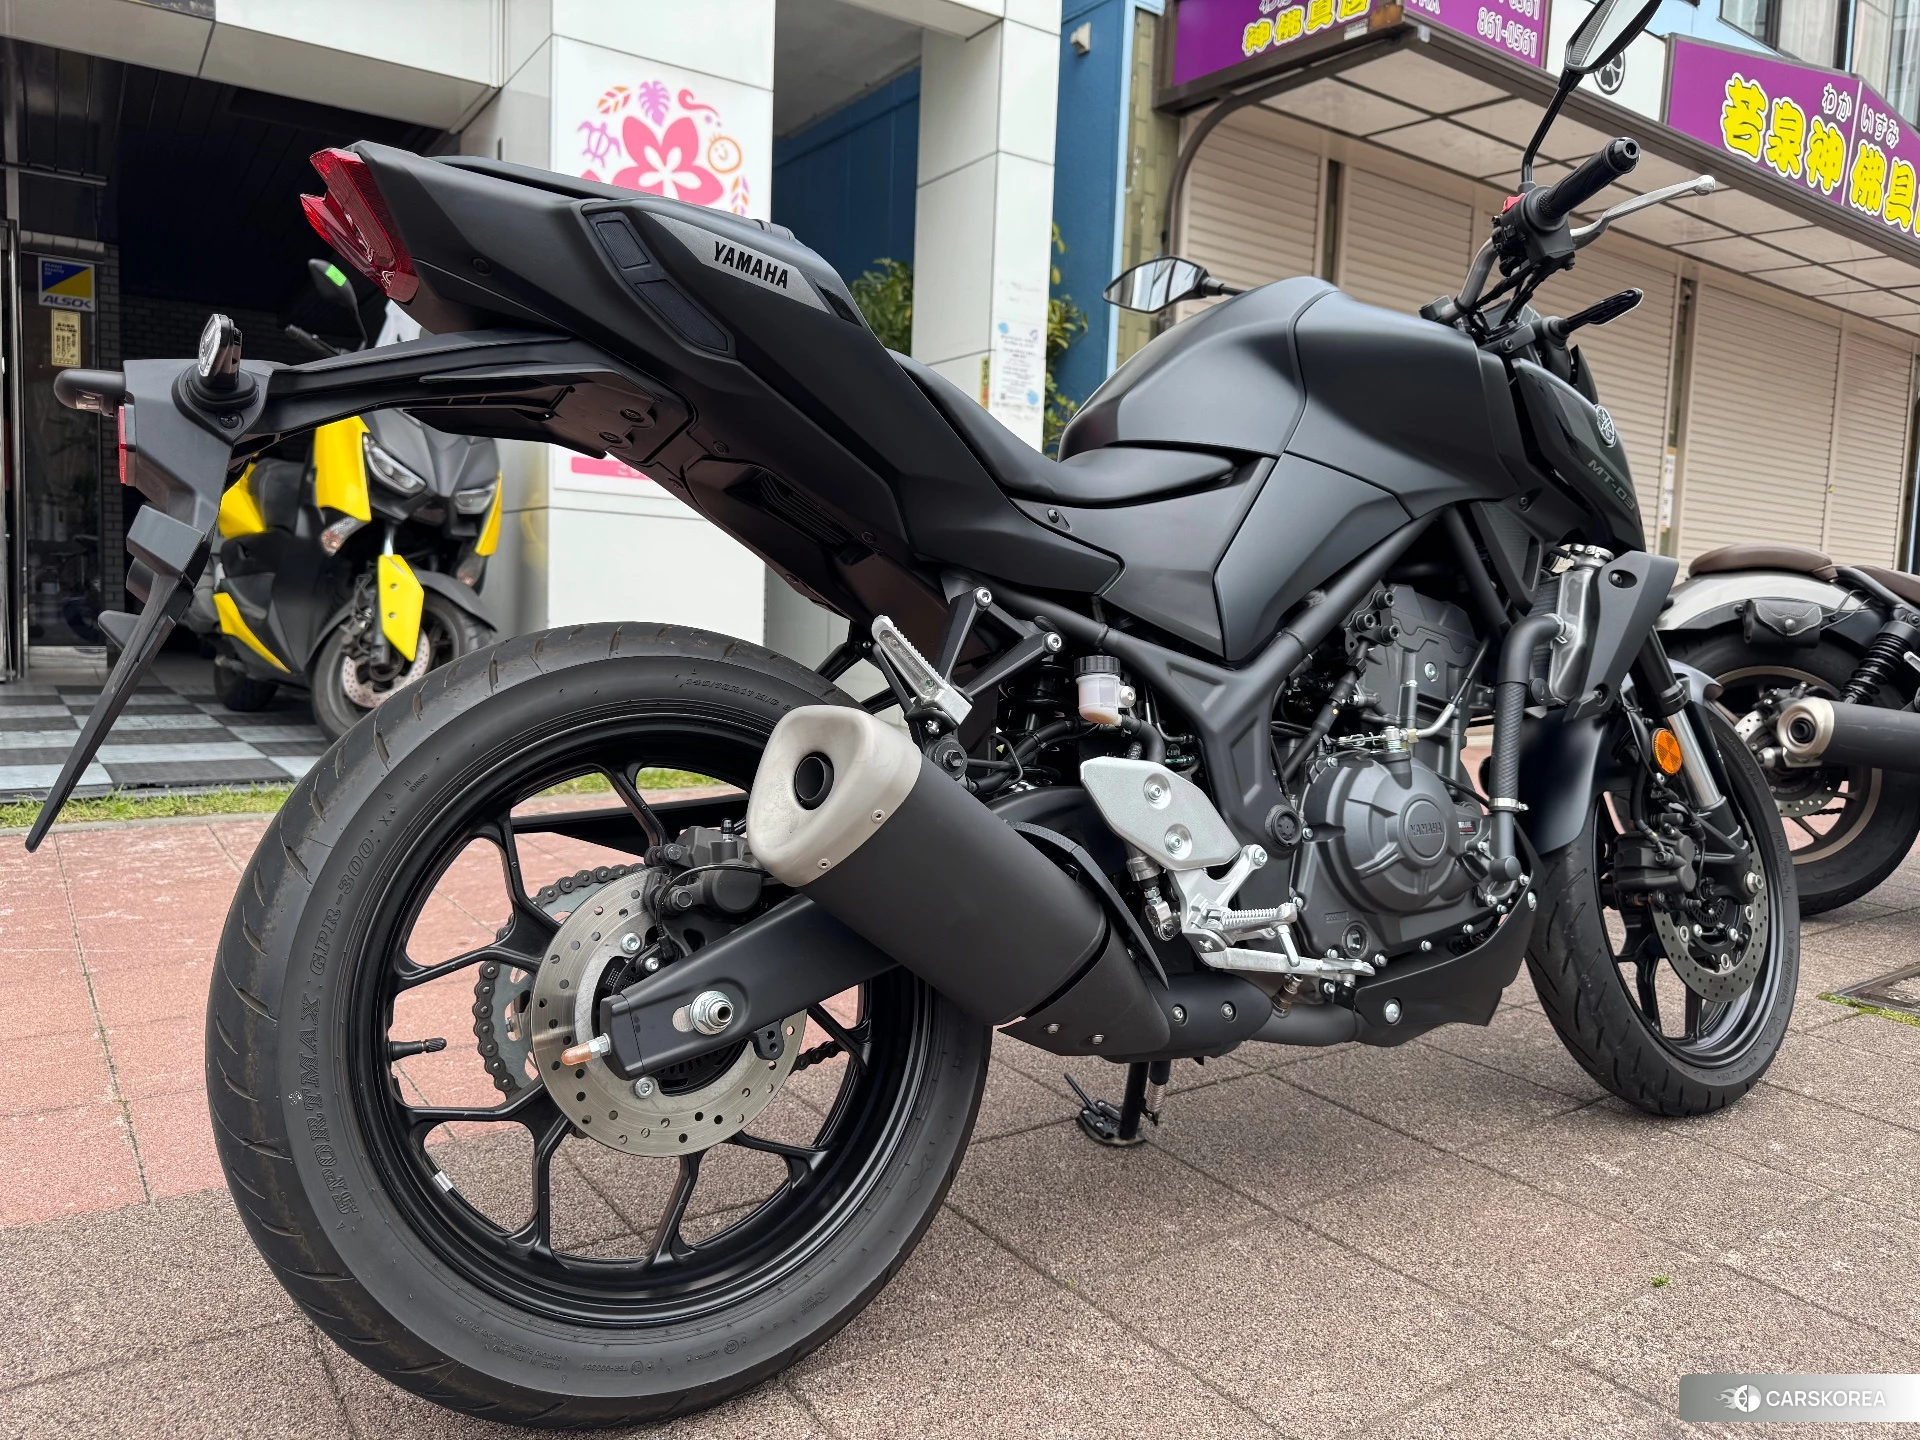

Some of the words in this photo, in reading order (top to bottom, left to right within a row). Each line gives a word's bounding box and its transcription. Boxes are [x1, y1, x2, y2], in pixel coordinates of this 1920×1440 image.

[1477, 7, 1538, 58] 861-0561
[1720, 72, 1920, 237] 若泉神佛具
[713, 240, 789, 290] YAMAHA
[43, 294, 92, 310] ALSOK
[1587, 459, 1635, 511] MT-03
[1409, 821, 1444, 836] YAMAHA
[311, 836, 375, 977] GPR-300
[298, 992, 360, 1216] SPORTMAX
